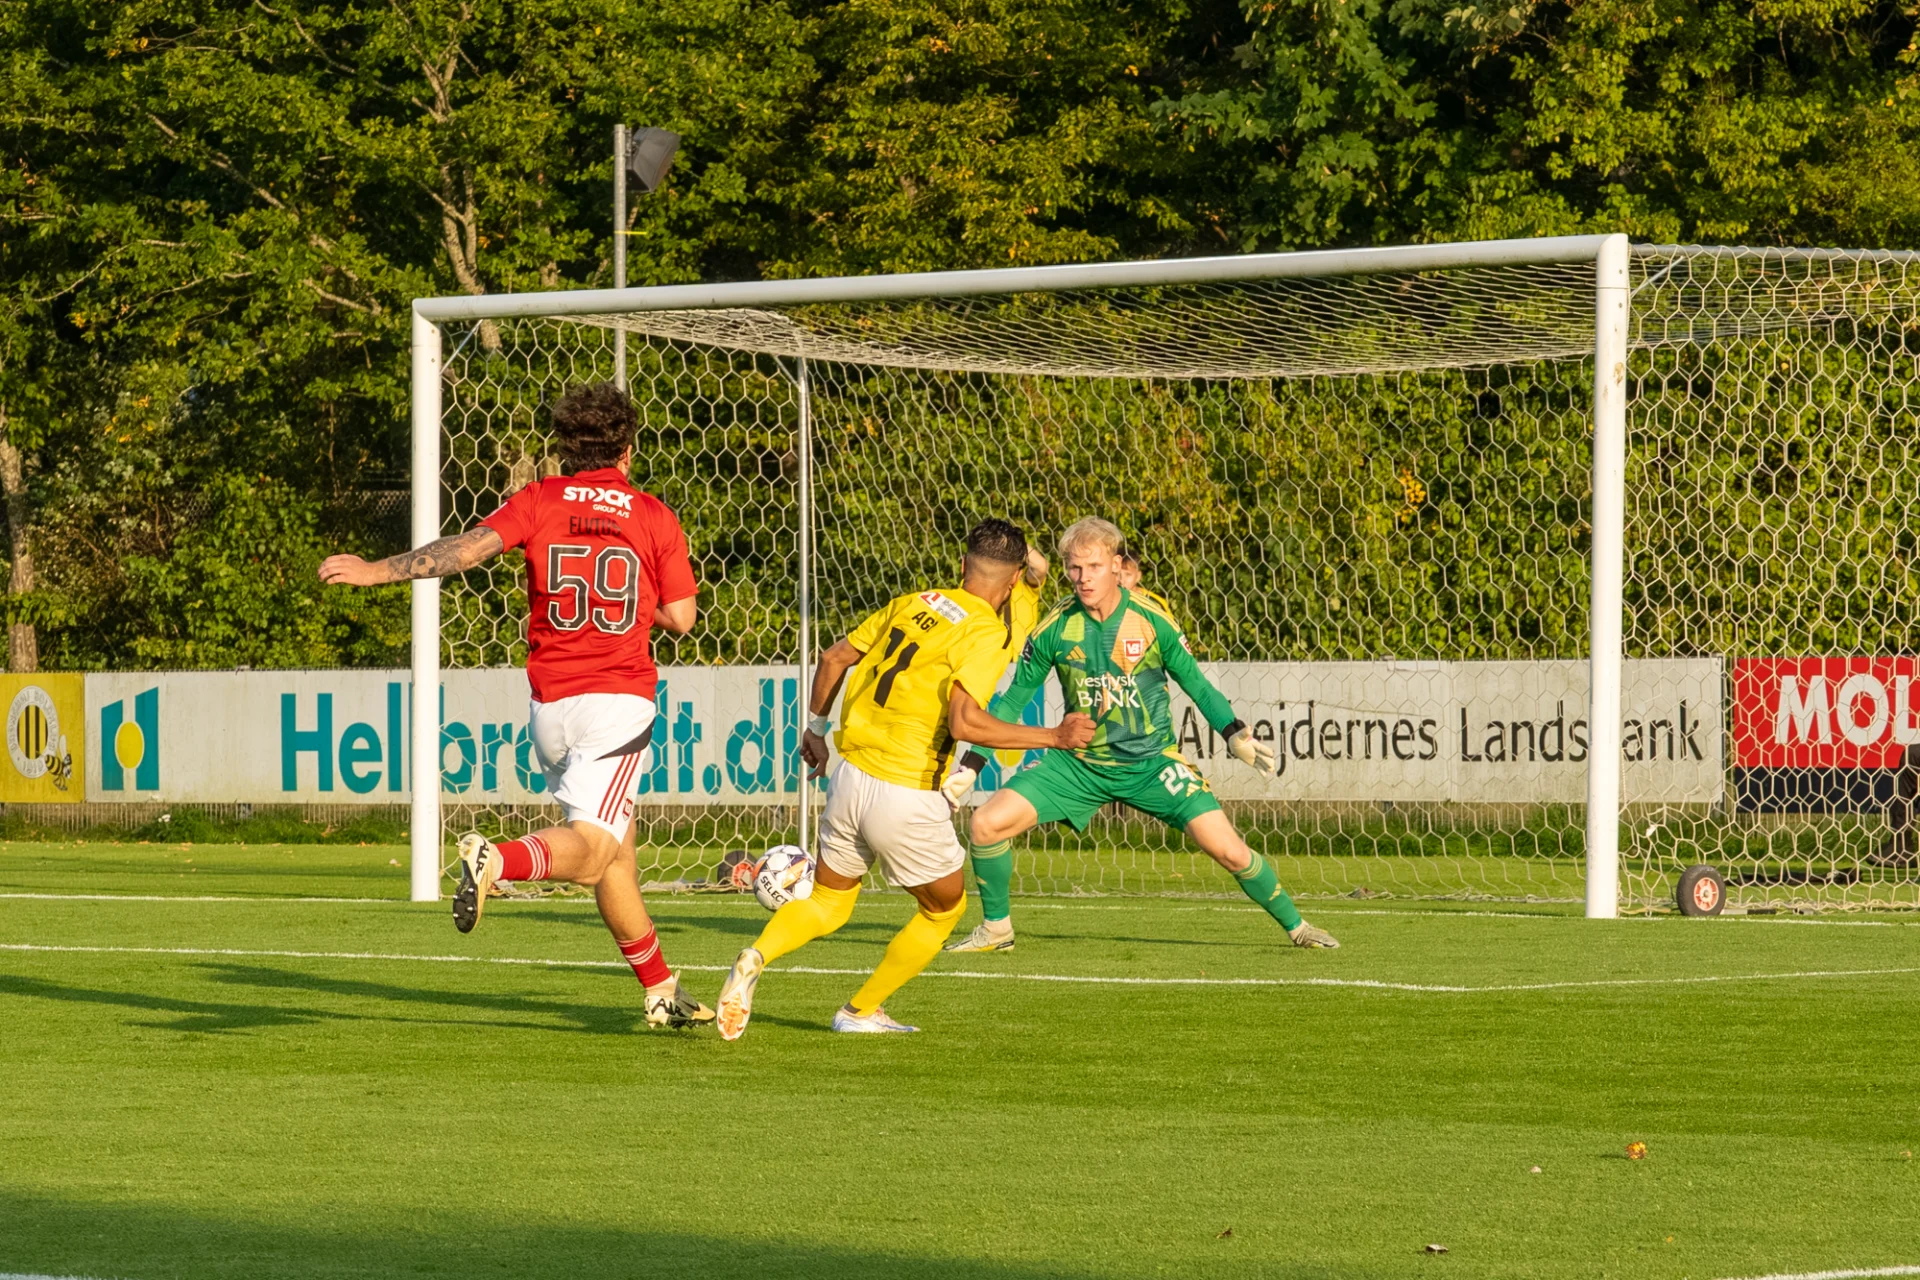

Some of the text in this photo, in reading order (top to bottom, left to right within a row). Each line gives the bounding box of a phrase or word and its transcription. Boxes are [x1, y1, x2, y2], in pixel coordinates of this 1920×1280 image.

[592, 504, 630, 519] GROUP A/S
[548, 544, 640, 634] 59
[873, 626, 920, 708] 11
[1075, 674, 1138, 691] vestjysk
[1076, 689, 1141, 710] BANK
[1461, 699, 1704, 763] Landsank
[1159, 763, 1197, 796] 24
[760, 875, 789, 905] SELECT
